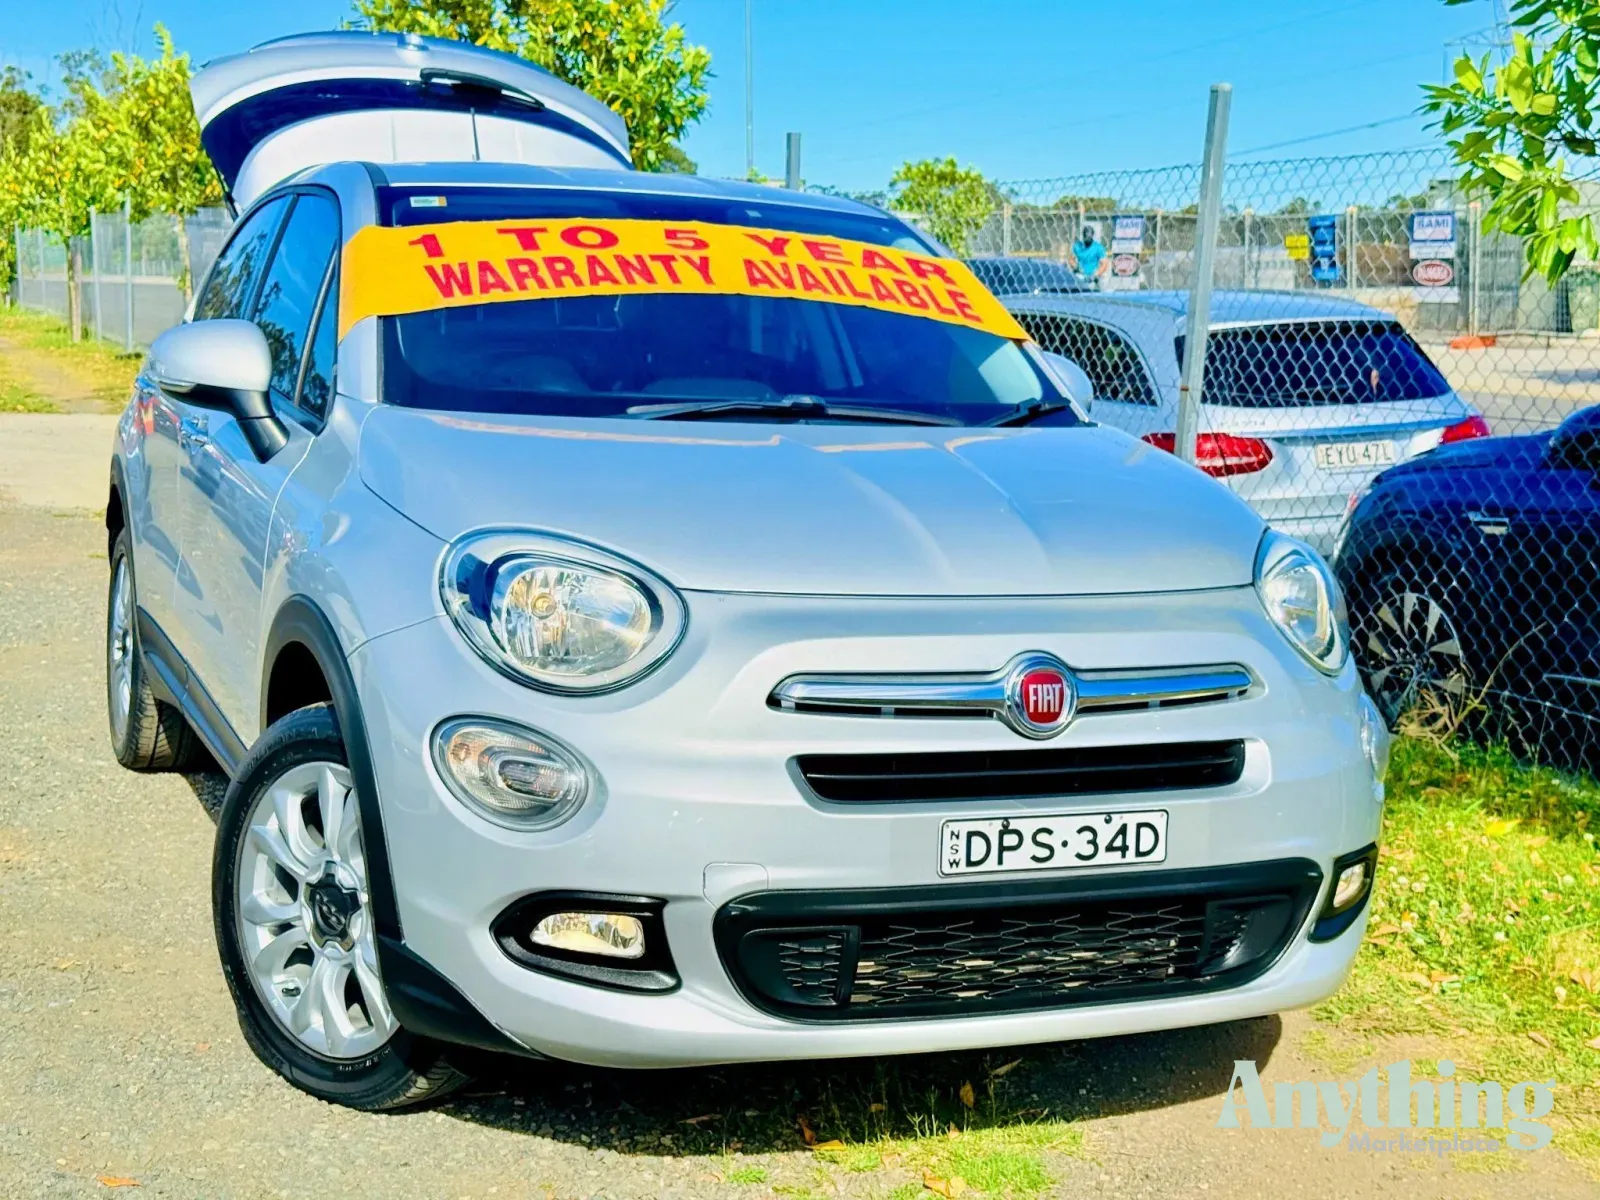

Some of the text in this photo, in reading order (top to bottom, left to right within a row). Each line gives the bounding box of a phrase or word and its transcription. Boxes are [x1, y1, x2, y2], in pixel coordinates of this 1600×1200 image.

[408, 225, 958, 286] 1 TO 5 YEAR
[423, 254, 983, 324] WARRANTY AVAILABLE
[1028, 683, 1062, 713] FIAT
